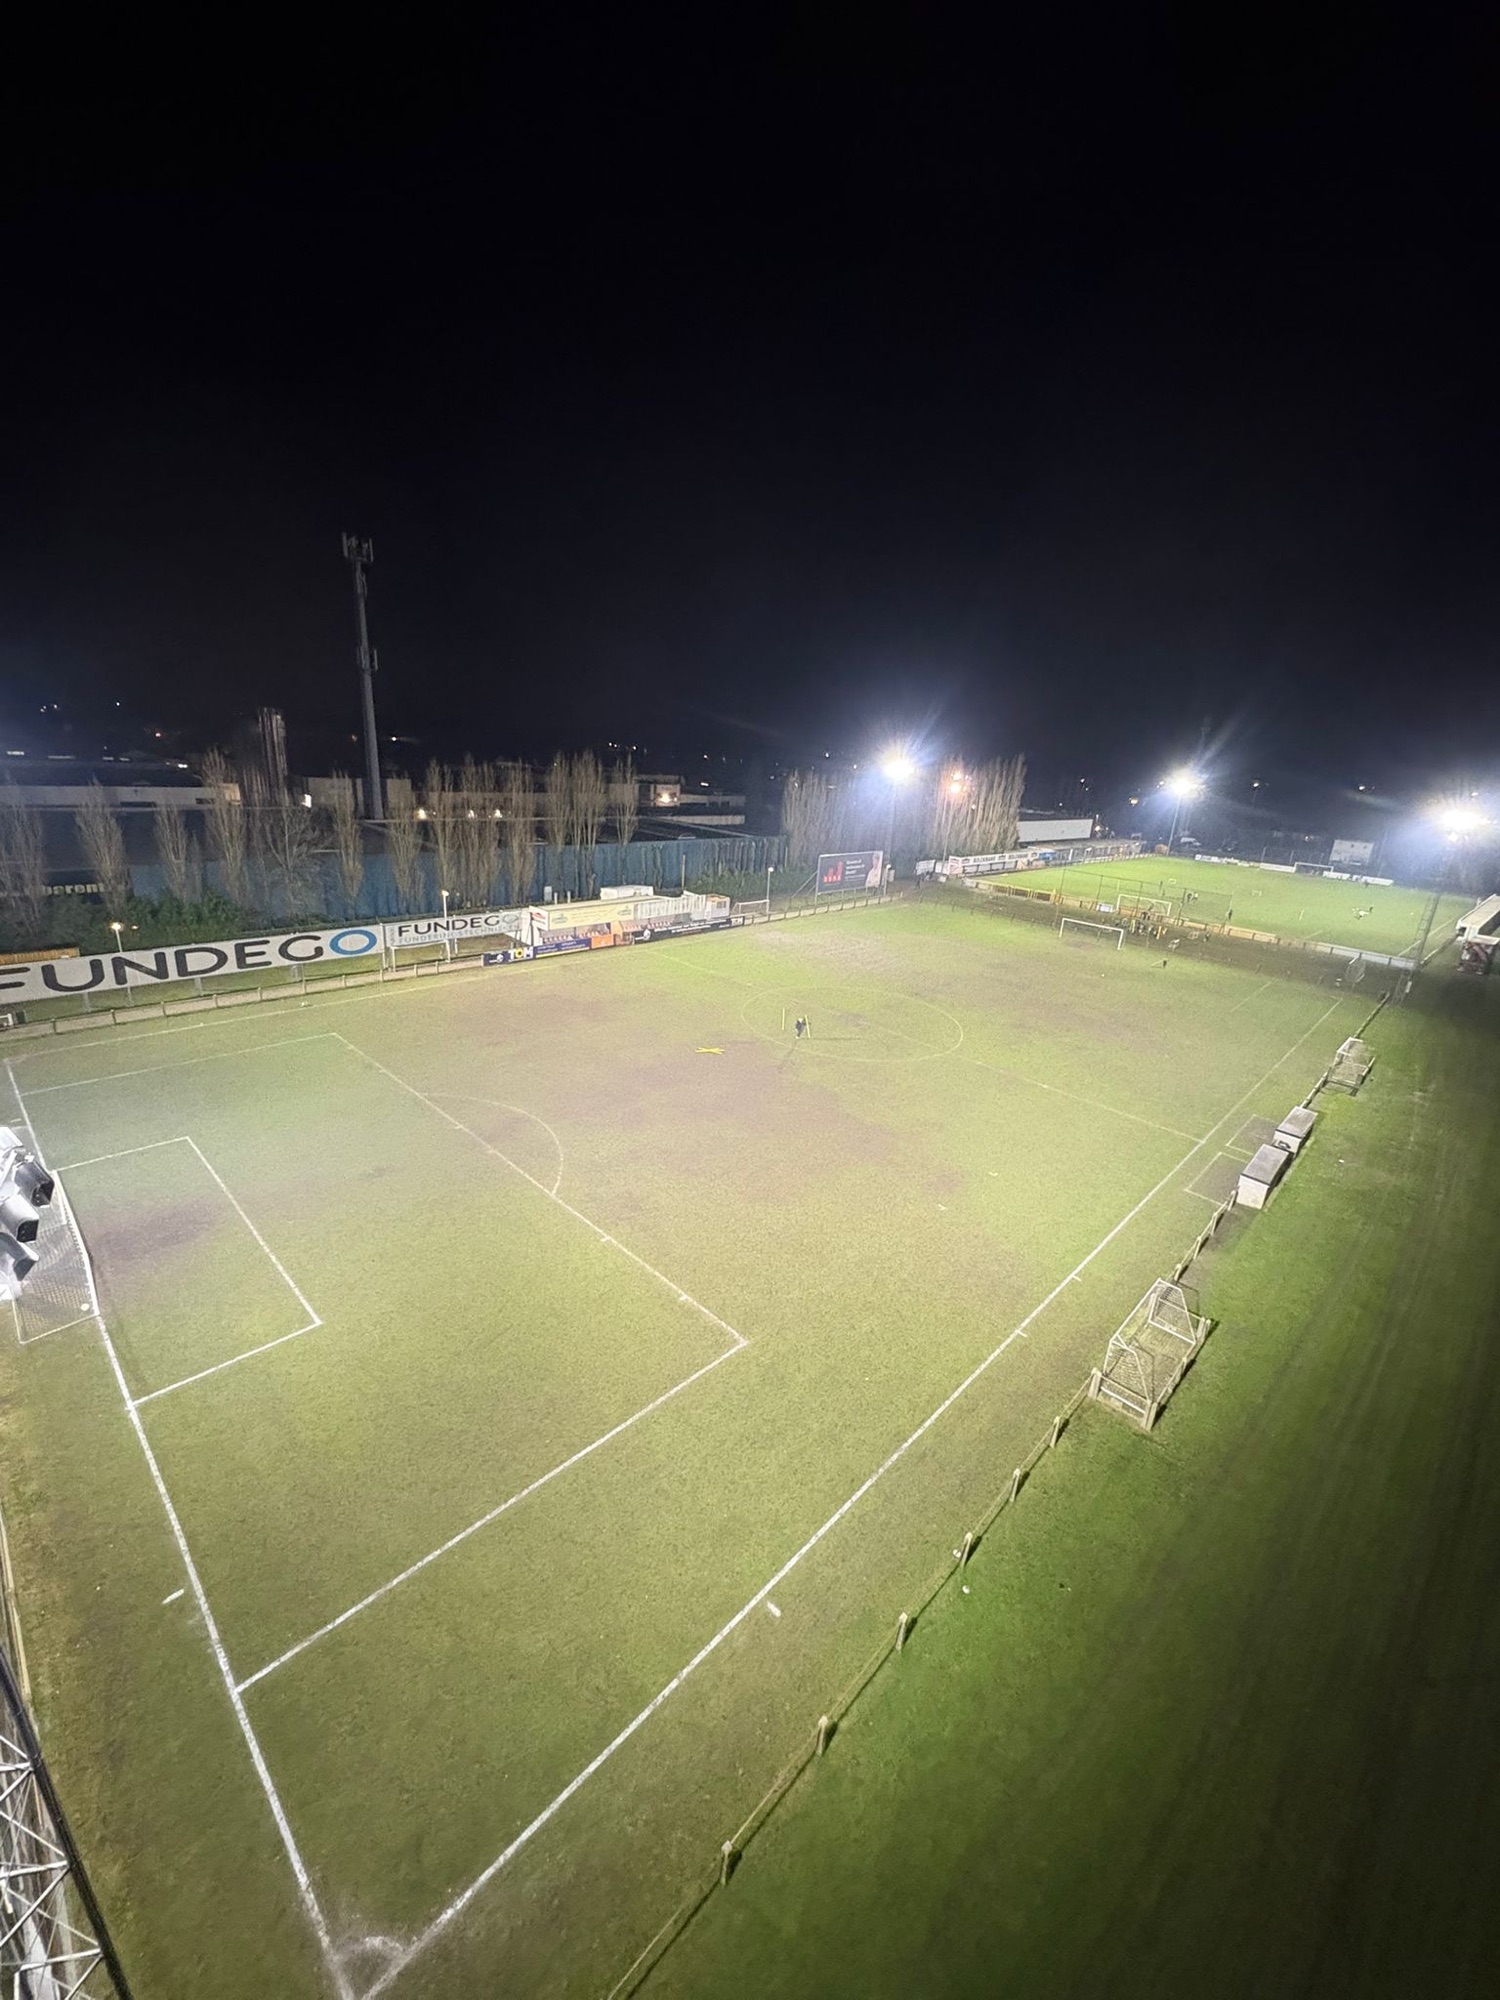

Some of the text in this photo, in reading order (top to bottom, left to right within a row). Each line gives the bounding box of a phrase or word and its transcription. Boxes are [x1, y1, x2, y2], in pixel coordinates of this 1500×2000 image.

[398, 914, 519, 937] FUNDEGO
[0, 929, 377, 992] FUNDEGO
[508, 946, 534, 961] TOM
